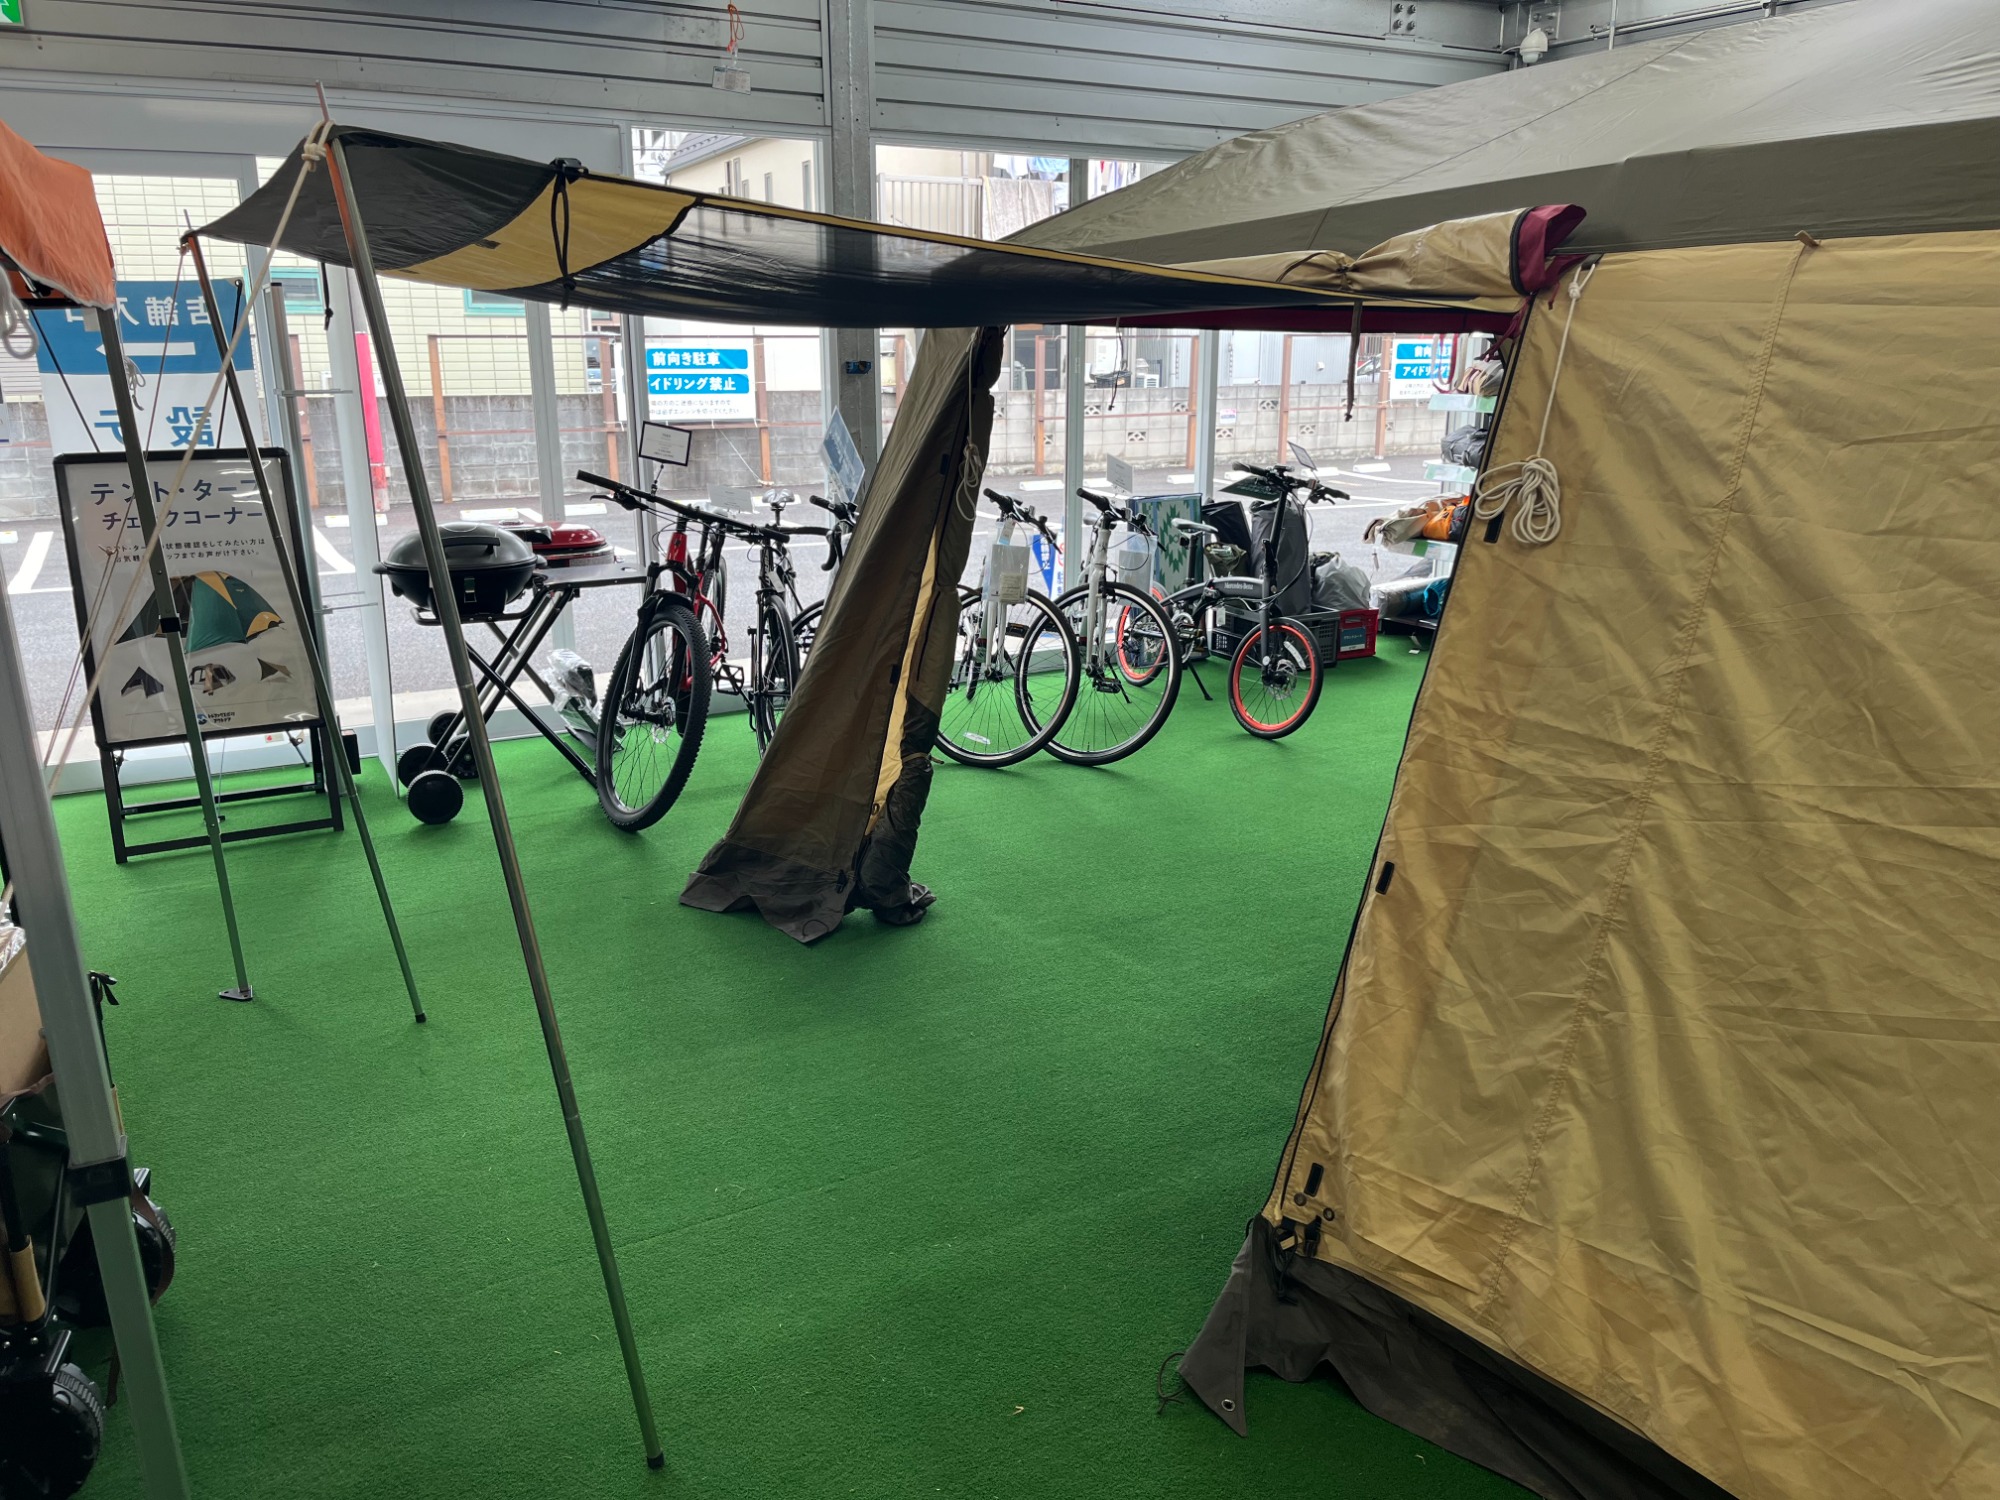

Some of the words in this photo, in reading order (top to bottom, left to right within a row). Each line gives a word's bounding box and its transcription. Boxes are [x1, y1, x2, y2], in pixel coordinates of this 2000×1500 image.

[652, 351, 720, 366] 前向き駐車
[648, 376, 737, 391] イドリング禁止
[102, 507, 263, 531] チェクコーナー
